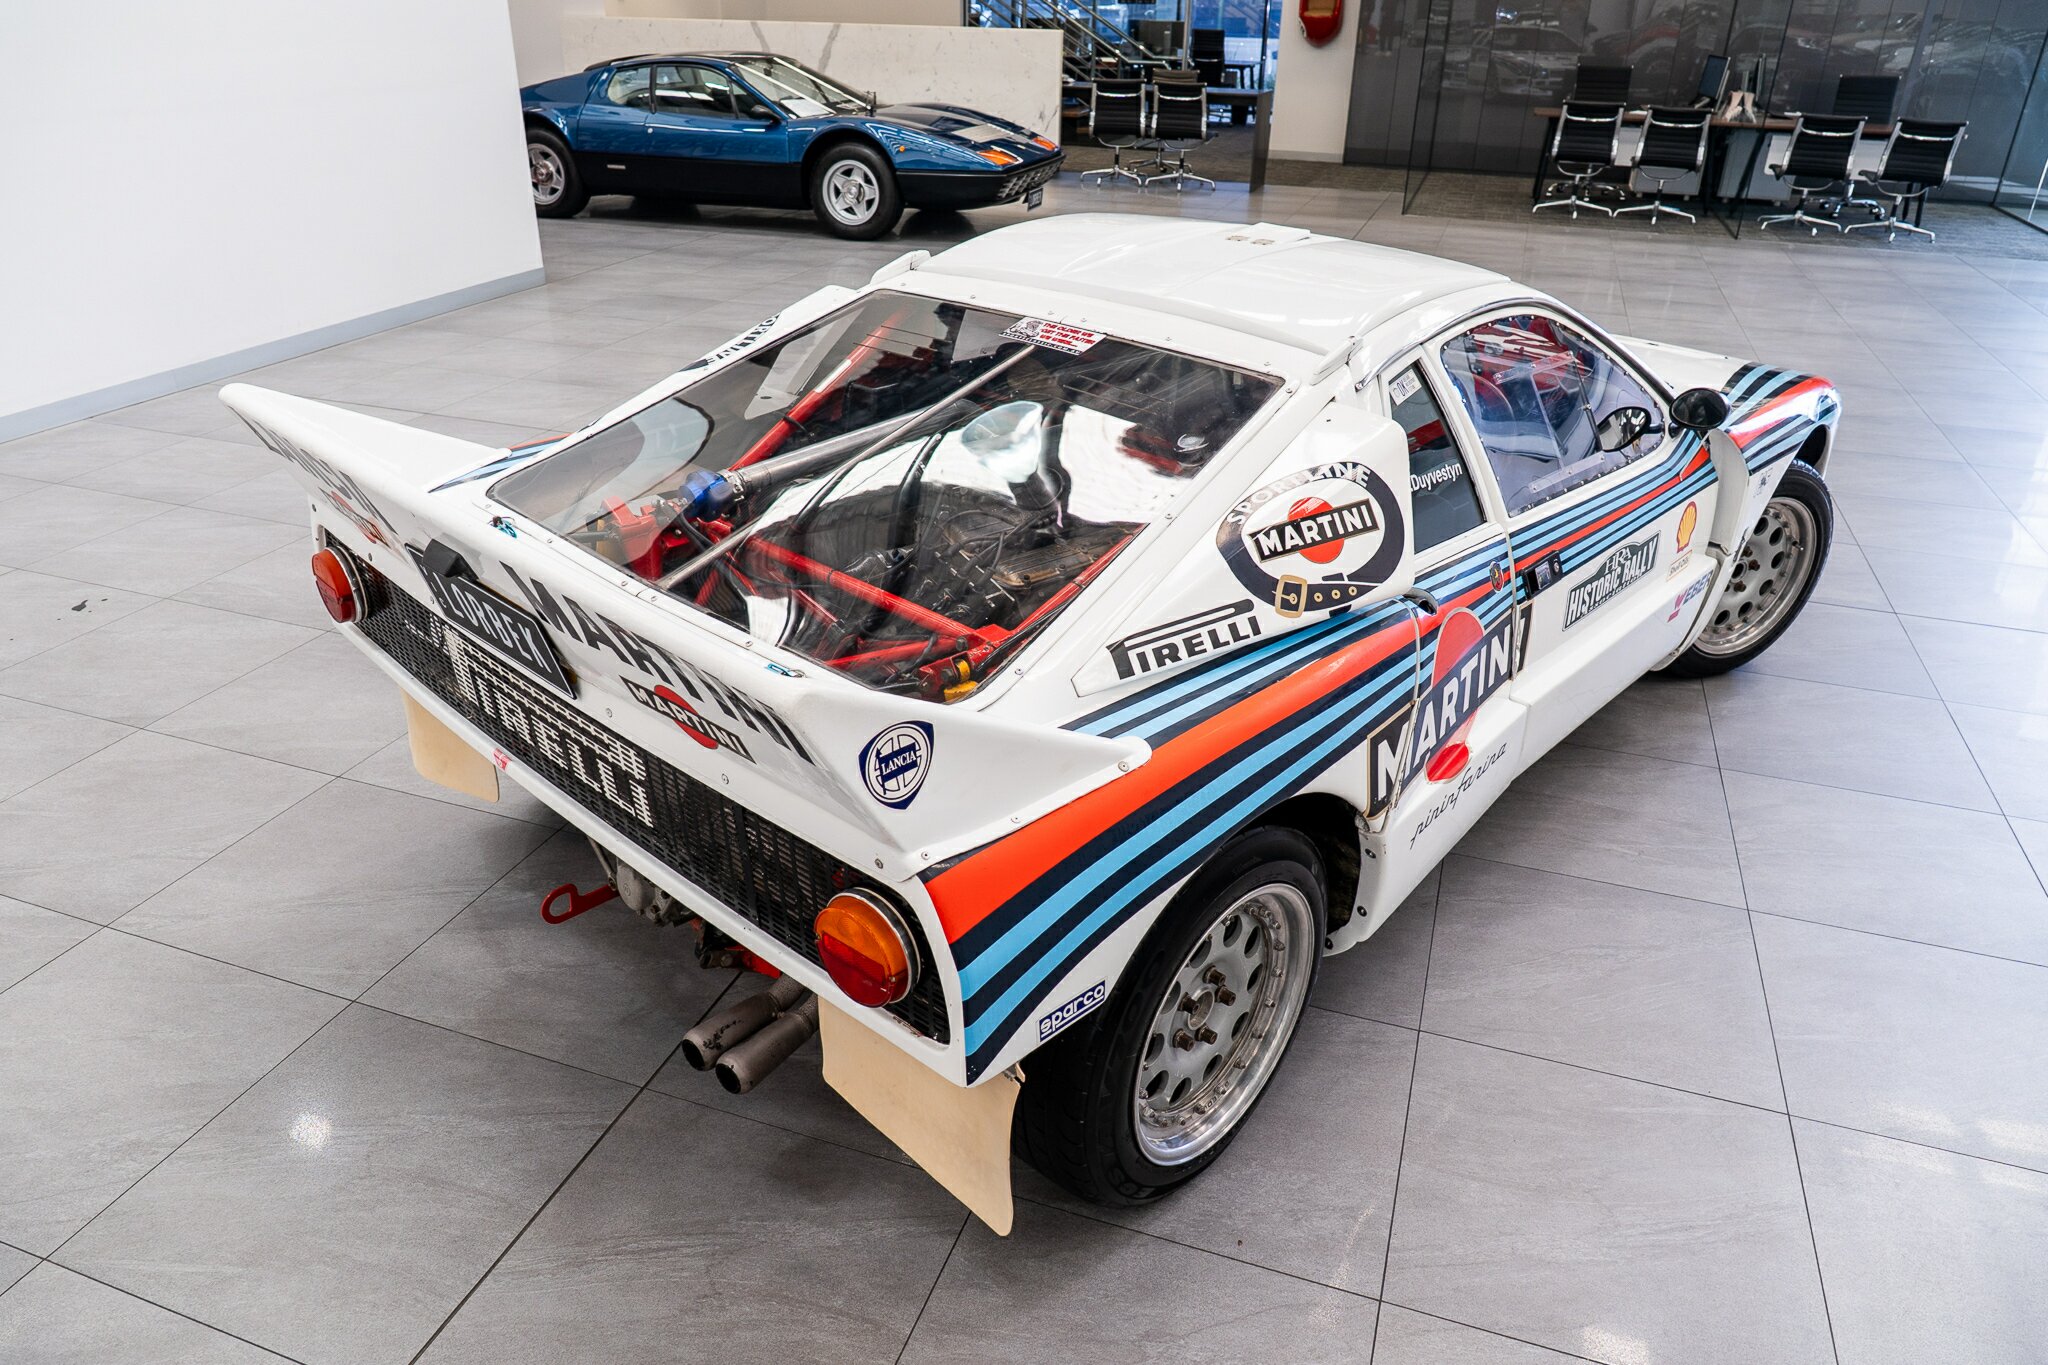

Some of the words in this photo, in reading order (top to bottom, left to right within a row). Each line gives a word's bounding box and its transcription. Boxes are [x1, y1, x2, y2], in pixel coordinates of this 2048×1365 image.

[1256, 504, 1373, 556] MARTINI
[1604, 546, 1632, 575] HRA
[432, 571, 552, 674] LORBEK
[1566, 566, 1622, 627] HISTORIC
[1621, 535, 1658, 583] RALLY
[499, 560, 816, 767] MARTINI
[1106, 598, 1262, 680] PIRELLI
[404, 608, 654, 828] PIRELLI
[627, 680, 743, 756] MARTINI
[1377, 616, 1526, 801] MARTINI
[881, 750, 917, 775] LANCIA
[1409, 741, 1508, 851] pininfarina
[1040, 984, 1105, 1034] sparco
